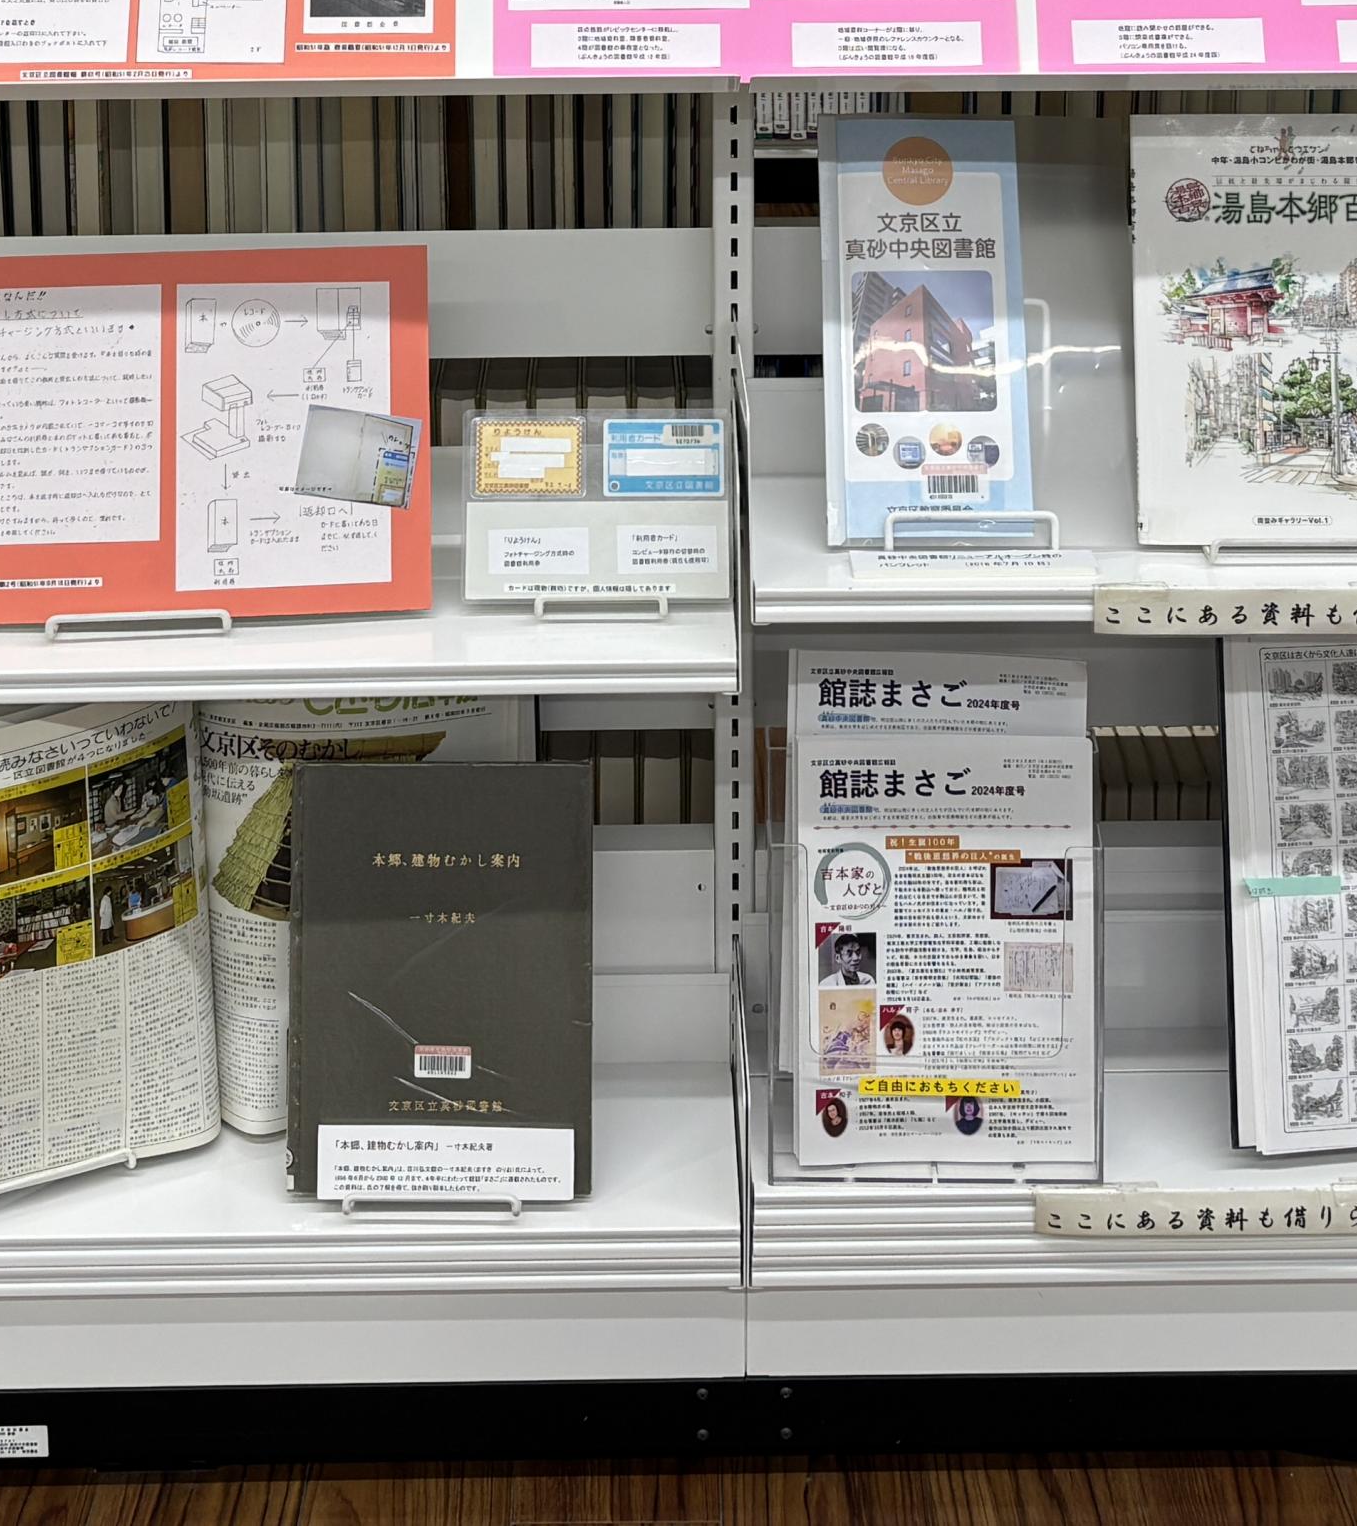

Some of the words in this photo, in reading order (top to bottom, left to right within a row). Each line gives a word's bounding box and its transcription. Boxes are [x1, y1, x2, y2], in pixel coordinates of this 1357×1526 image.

[876, 212, 964, 234] 文京区立
[845, 238, 996, 260] 真砂中央図書館
[492, 427, 542, 437] りようけん
[610, 433, 660, 443] 利用者カード
[818, 677, 968, 708] 館誌まさご
[966, 698, 1021, 711] 2024年度号
[819, 767, 972, 799] 館誌まさご
[971, 785, 1027, 797] 2024年度号
[372, 852, 522, 869] 本郷、建物むかし案内
[820, 866, 875, 880] 吉本家の
[842, 883, 884, 897] 人びと
[863, 1079, 1016, 1094] ご自由におもちください
